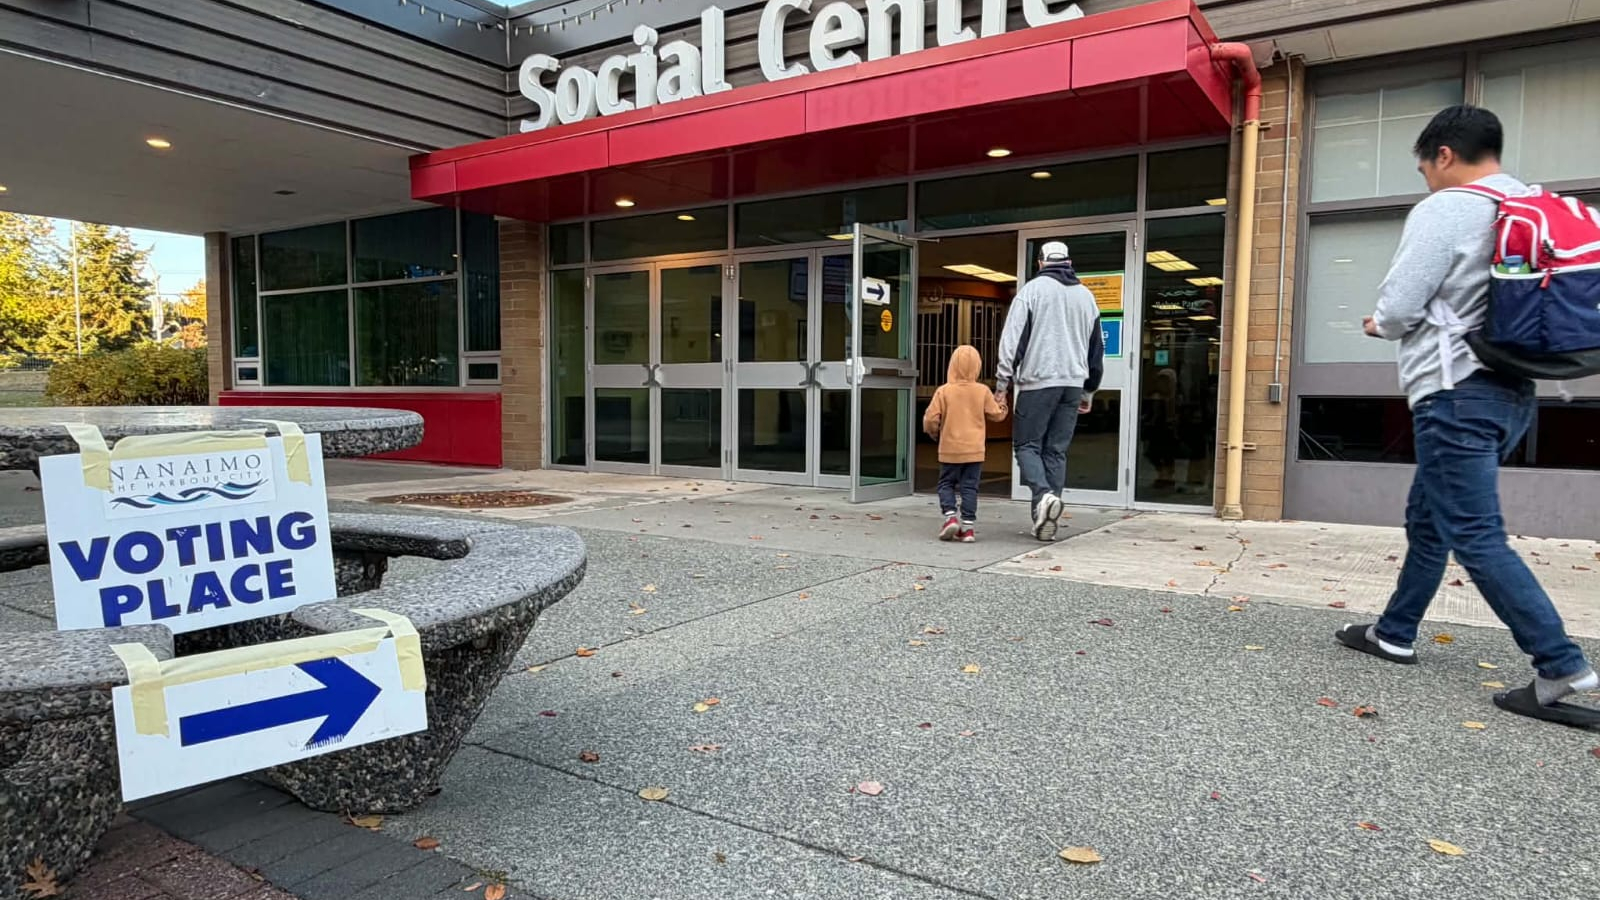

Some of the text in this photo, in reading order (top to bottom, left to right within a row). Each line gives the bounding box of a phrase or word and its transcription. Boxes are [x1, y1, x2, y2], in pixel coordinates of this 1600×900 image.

[518, 5, 733, 133] Social
[109, 454, 261, 482] NANAIMO
[111, 471, 262, 493] HE HARBOUR CITY
[58, 511, 317, 582] VOTING
[98, 558, 297, 628] PLACE
